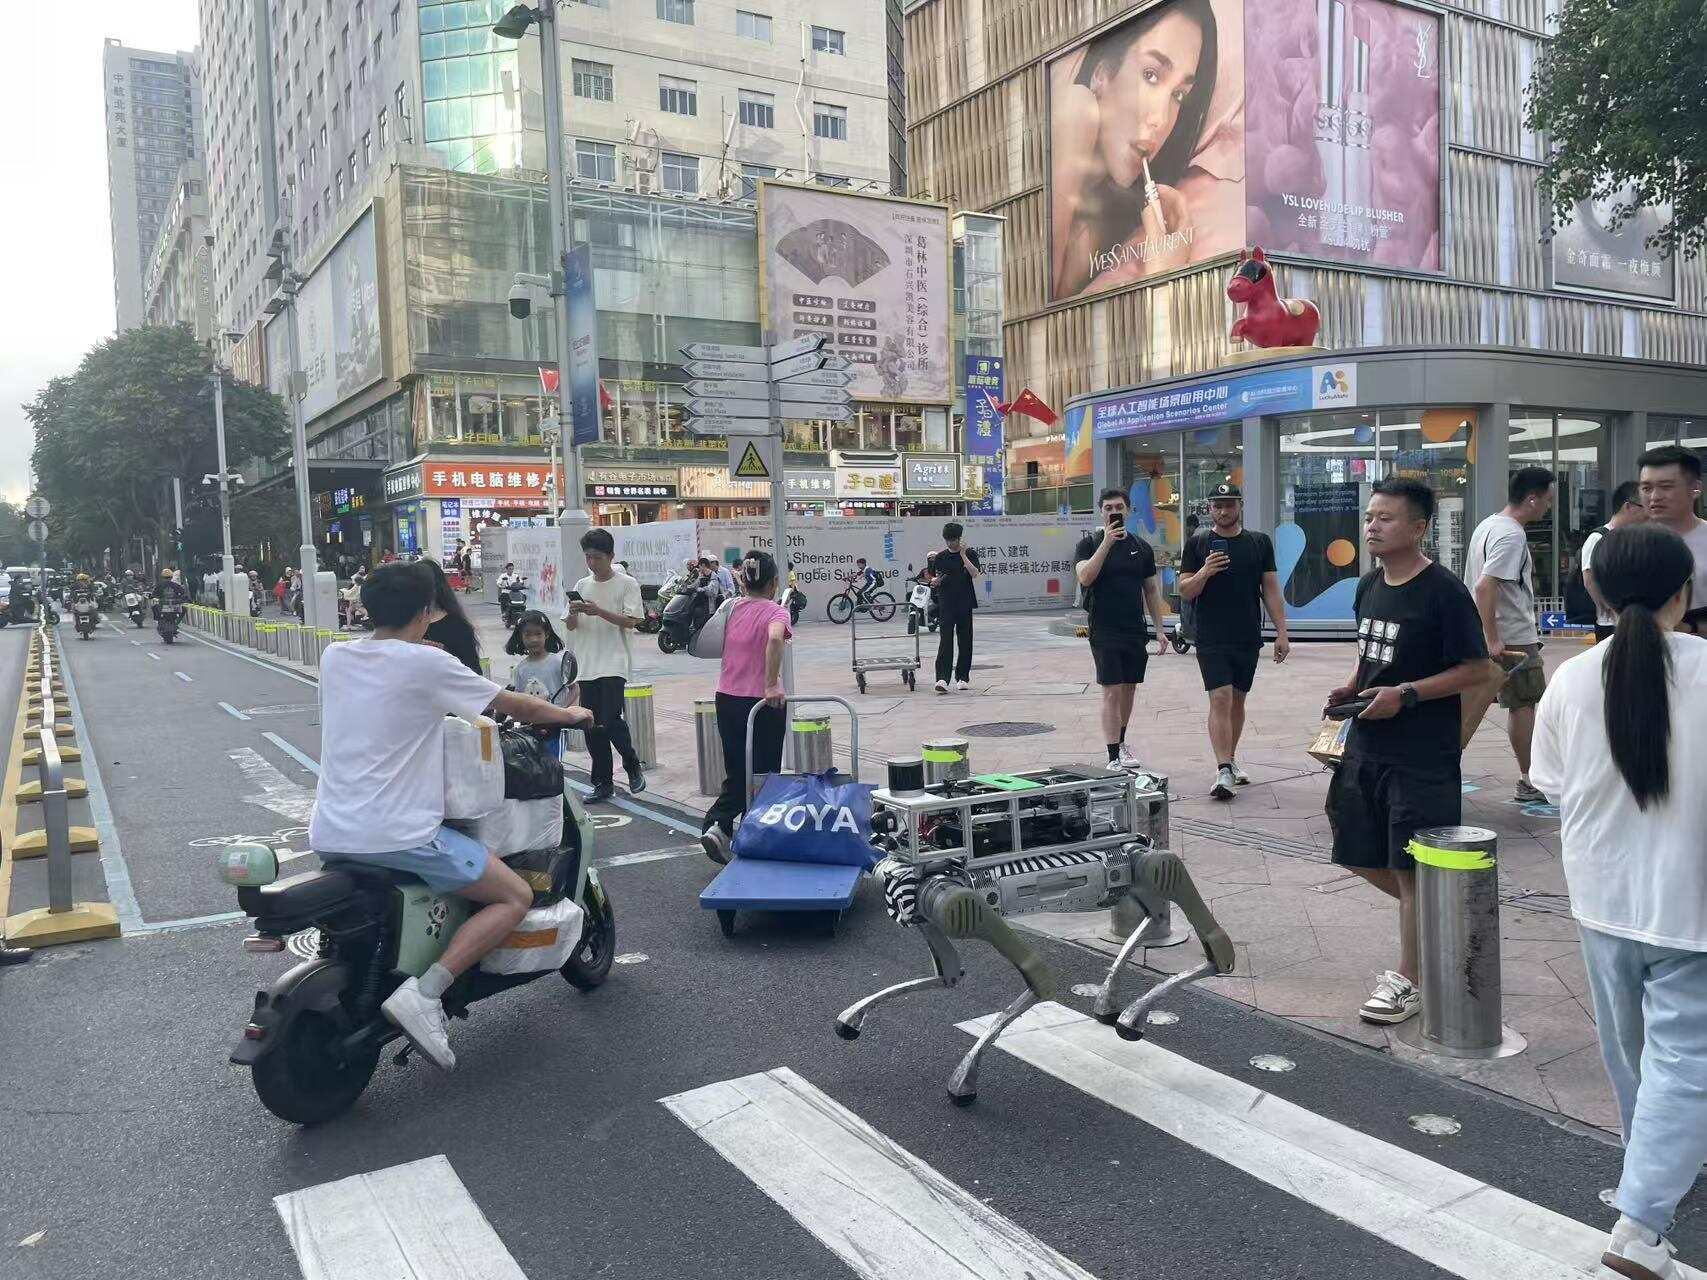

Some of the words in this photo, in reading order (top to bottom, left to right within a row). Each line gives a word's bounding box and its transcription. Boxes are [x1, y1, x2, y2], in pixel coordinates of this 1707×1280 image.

[1282, 193, 1299, 207] YSL
[1301, 197, 1351, 215] LOVENUDE
[1365, 207, 1404, 224] BLUSHER
[1297, 212, 1317, 230] 全新
[1089, 249, 1114, 279] YVES
[1108, 242, 1145, 272] SAINT
[1142, 226, 1194, 263] LAURENT
[1097, 385, 1228, 419] 全球人工智能场景应用中心
[1097, 419, 1118, 429] Global
[1127, 411, 1164, 425] Application
[1166, 408, 1201, 418] Scenarios
[1202, 402, 1228, 412] Center
[786, 478, 833, 490] 手机维修
[749, 536, 773, 547] The
[793, 552, 853, 564] Shenzhen
[970, 545, 1030, 559] 城市\建筑
[795, 568, 831, 583] ngbei
[759, 803, 860, 834] BOYA
